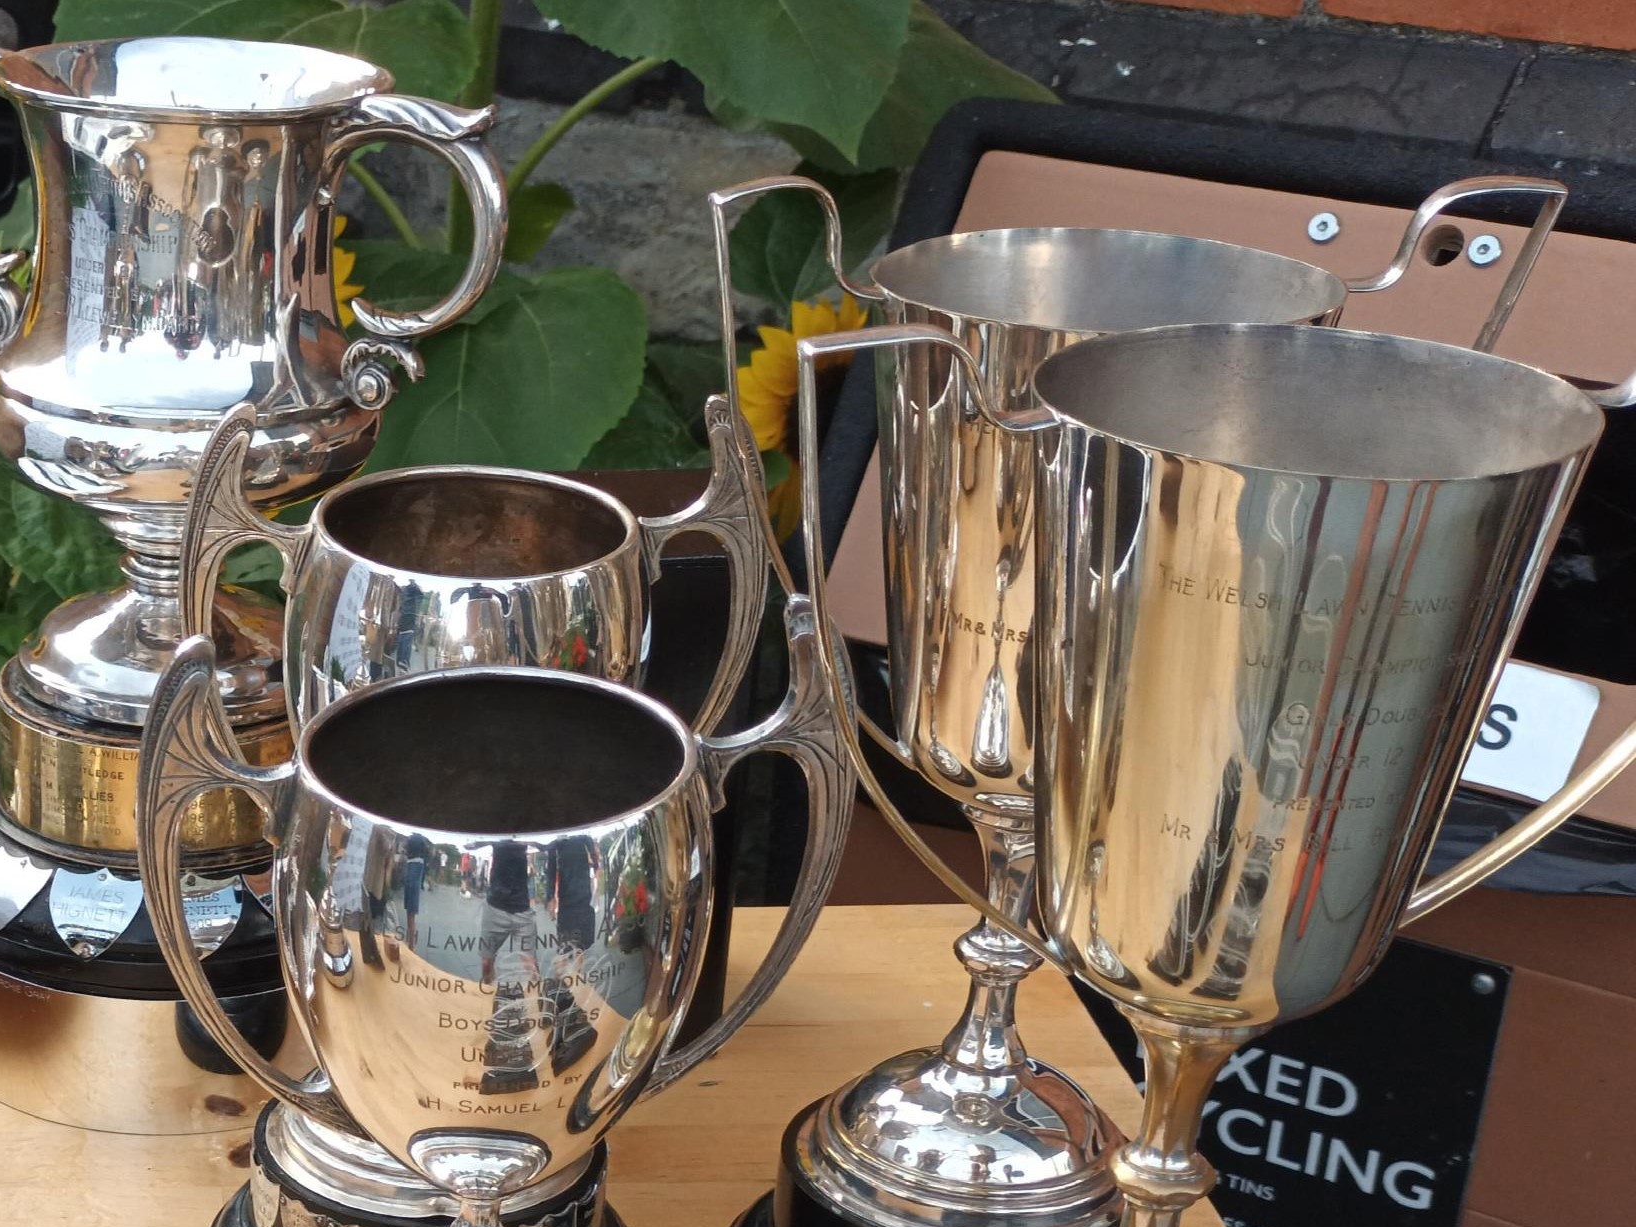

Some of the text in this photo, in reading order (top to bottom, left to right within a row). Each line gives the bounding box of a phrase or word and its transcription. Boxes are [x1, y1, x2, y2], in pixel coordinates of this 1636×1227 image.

[69, 886, 124, 905] JAMES
[390, 970, 466, 994] JUNIOR
[438, 1012, 496, 1032] BOYS
[1215, 1046, 1359, 1118] XED
[458, 1099, 542, 1114] SAMUEL
[1228, 1172, 1275, 1202] TINS
